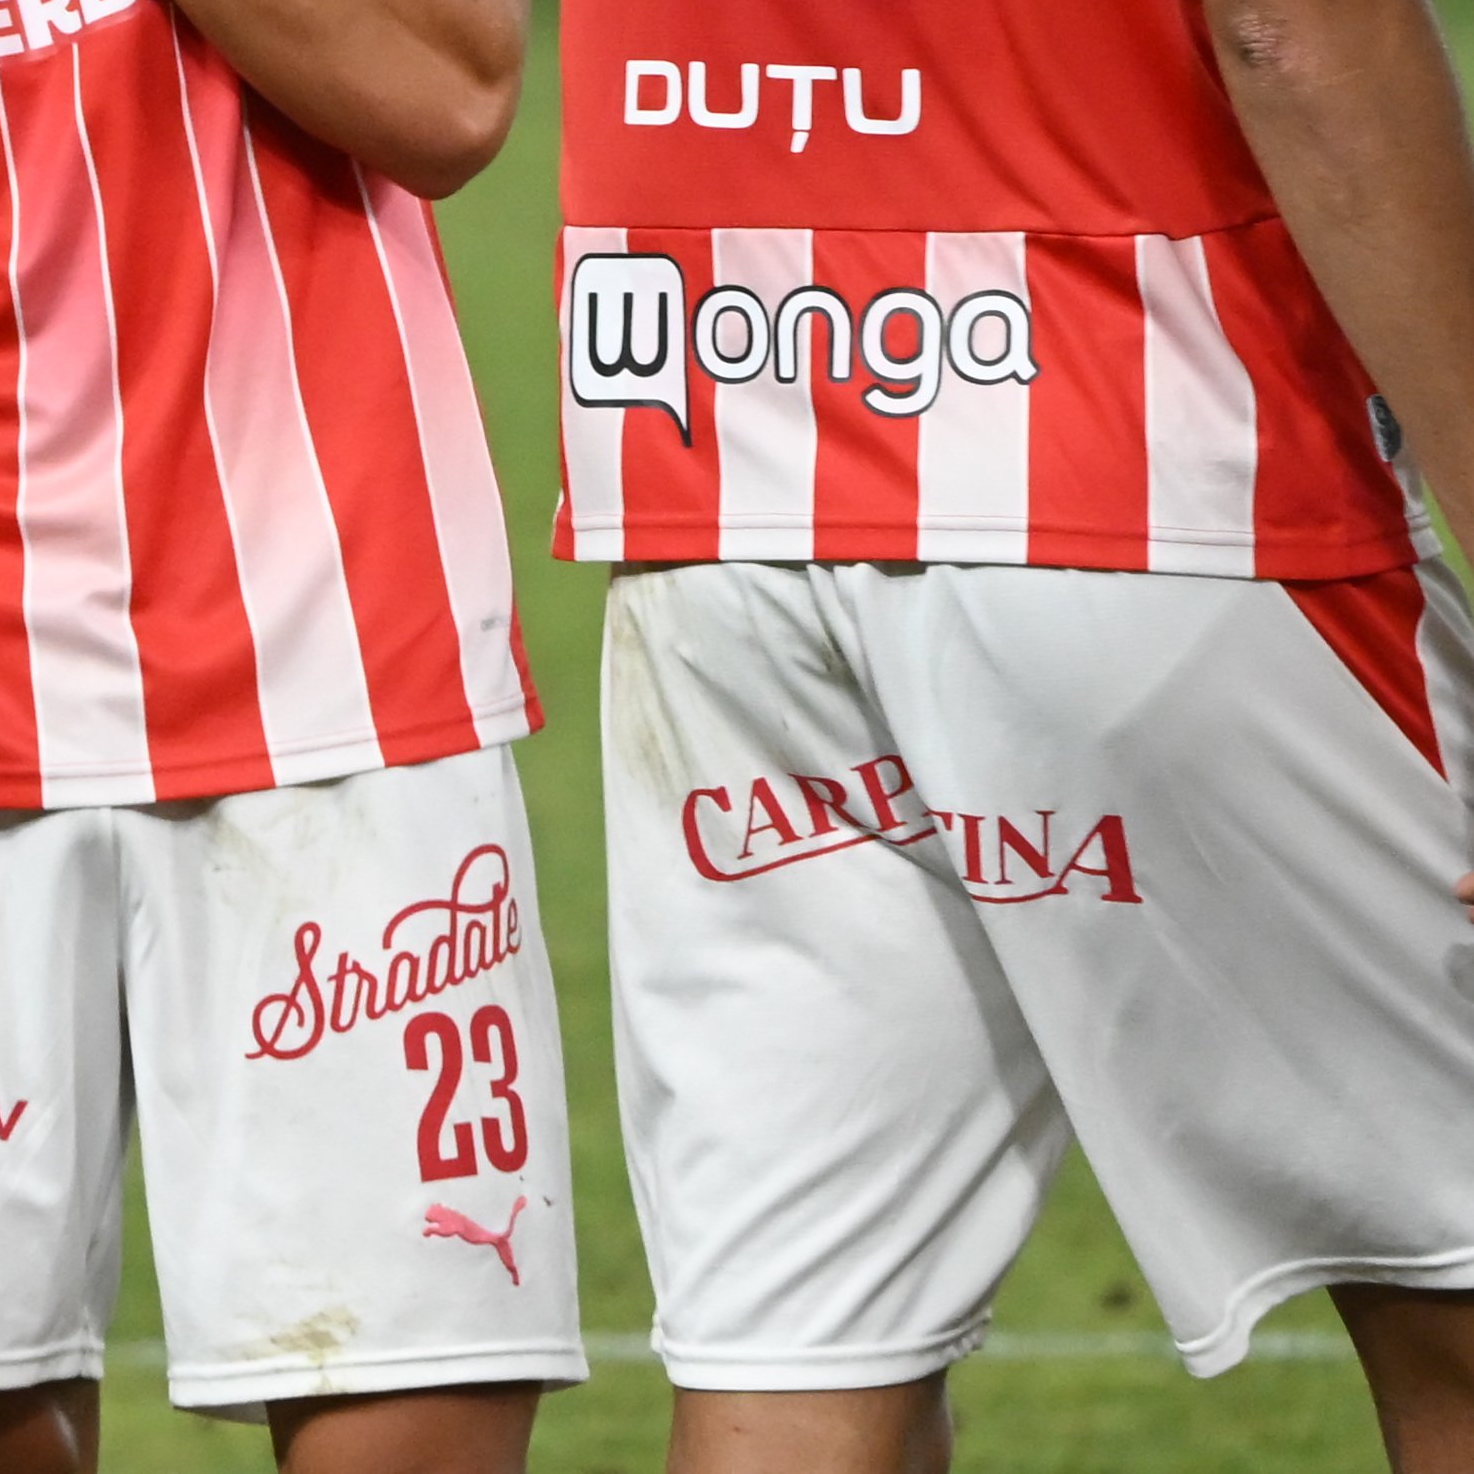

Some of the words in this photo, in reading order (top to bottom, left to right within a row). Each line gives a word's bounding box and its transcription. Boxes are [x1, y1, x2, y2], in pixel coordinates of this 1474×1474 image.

[623, 59, 923, 154] DUȚU
[681, 754, 1144, 905] CARPINA
[245, 844, 522, 1061] Stradale
[403, 1004, 528, 1183] 23
